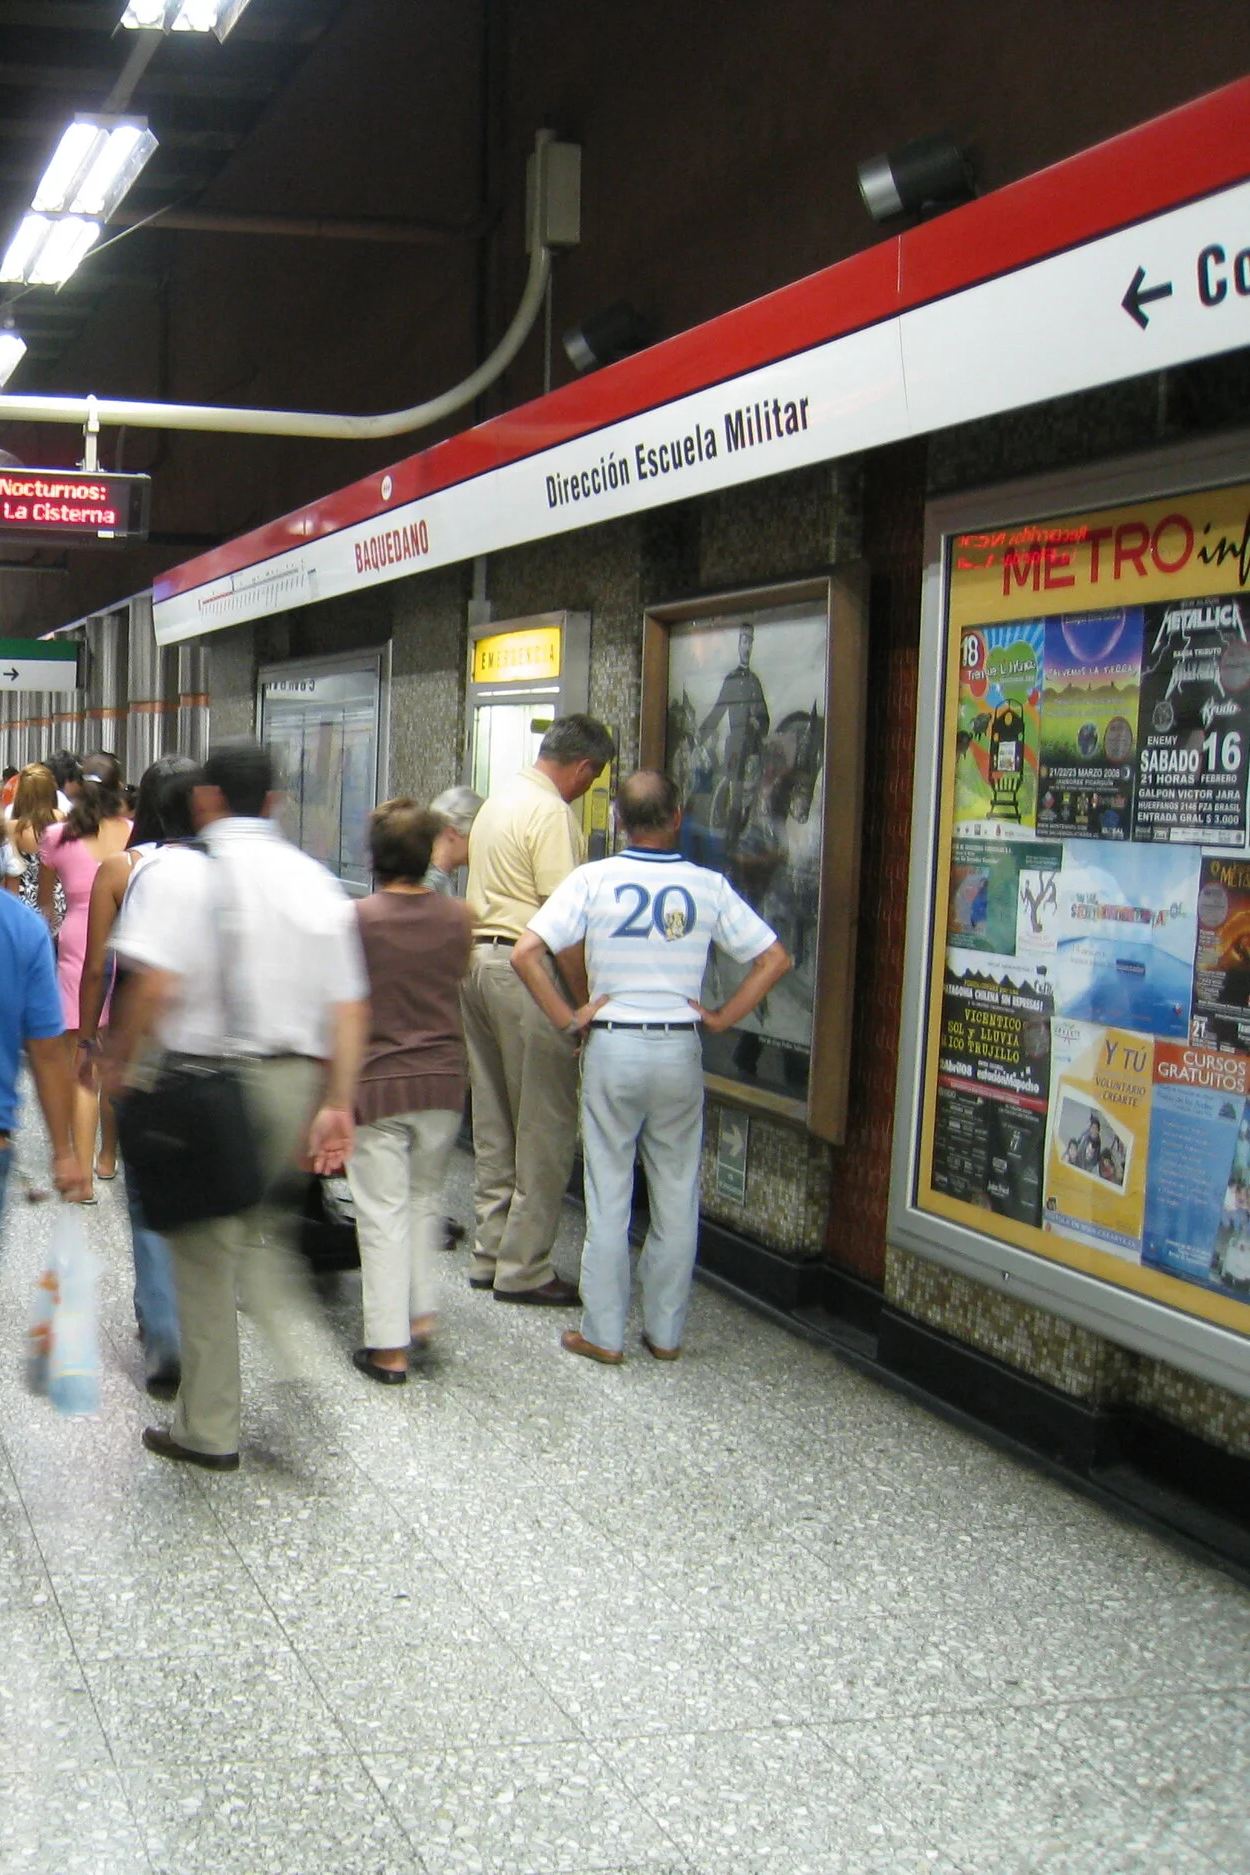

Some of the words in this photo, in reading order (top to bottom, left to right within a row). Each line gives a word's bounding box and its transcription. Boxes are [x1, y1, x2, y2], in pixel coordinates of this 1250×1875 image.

[1197, 243, 1250, 307] Co
[546, 452, 630, 509] Dirección
[635, 424, 718, 480] Escuela
[724, 396, 809, 453] Militar
[4, 502, 28, 520] La
[32, 502, 116, 525] Cisterna
[354, 519, 429, 573] BAQUEDANO
[1003, 512, 1194, 596] METRO
[961, 634, 979, 667] 18
[1140, 749, 1200, 772] SABADO
[1202, 731, 1241, 772] 16
[1147, 735, 1178, 745] ENEMY
[1077, 767, 1103, 777] MARZO
[1140, 774, 1153, 784] 21
[1156, 774, 1195, 785] HORAS
[1200, 774, 1237, 783] FEBRERO
[1138, 788, 1175, 798] GALPON
[1178, 789, 1213, 799] VICTOR
[1216, 789, 1240, 800] JARA
[1138, 812, 1177, 821] ENTRADA
[1180, 813, 1203, 823] GRAL
[1214, 803, 1240, 813] BRASIL
[609, 883, 697, 941] 20
[964, 1008, 1022, 1031] VICENTICO
[948, 1021, 964, 1034] SOL
[980, 1027, 1019, 1047] LLUVIA
[968, 1040, 1020, 1063] TRUJILLO
[1105, 1039, 1118, 1066] Y
[1123, 1045, 1147, 1073] TÚ
[1183, 1051, 1247, 1076] CURSOS
[1095, 1075, 1146, 1095] VOLUNTARIO
[1158, 1062, 1245, 1093] GRATUITOS
